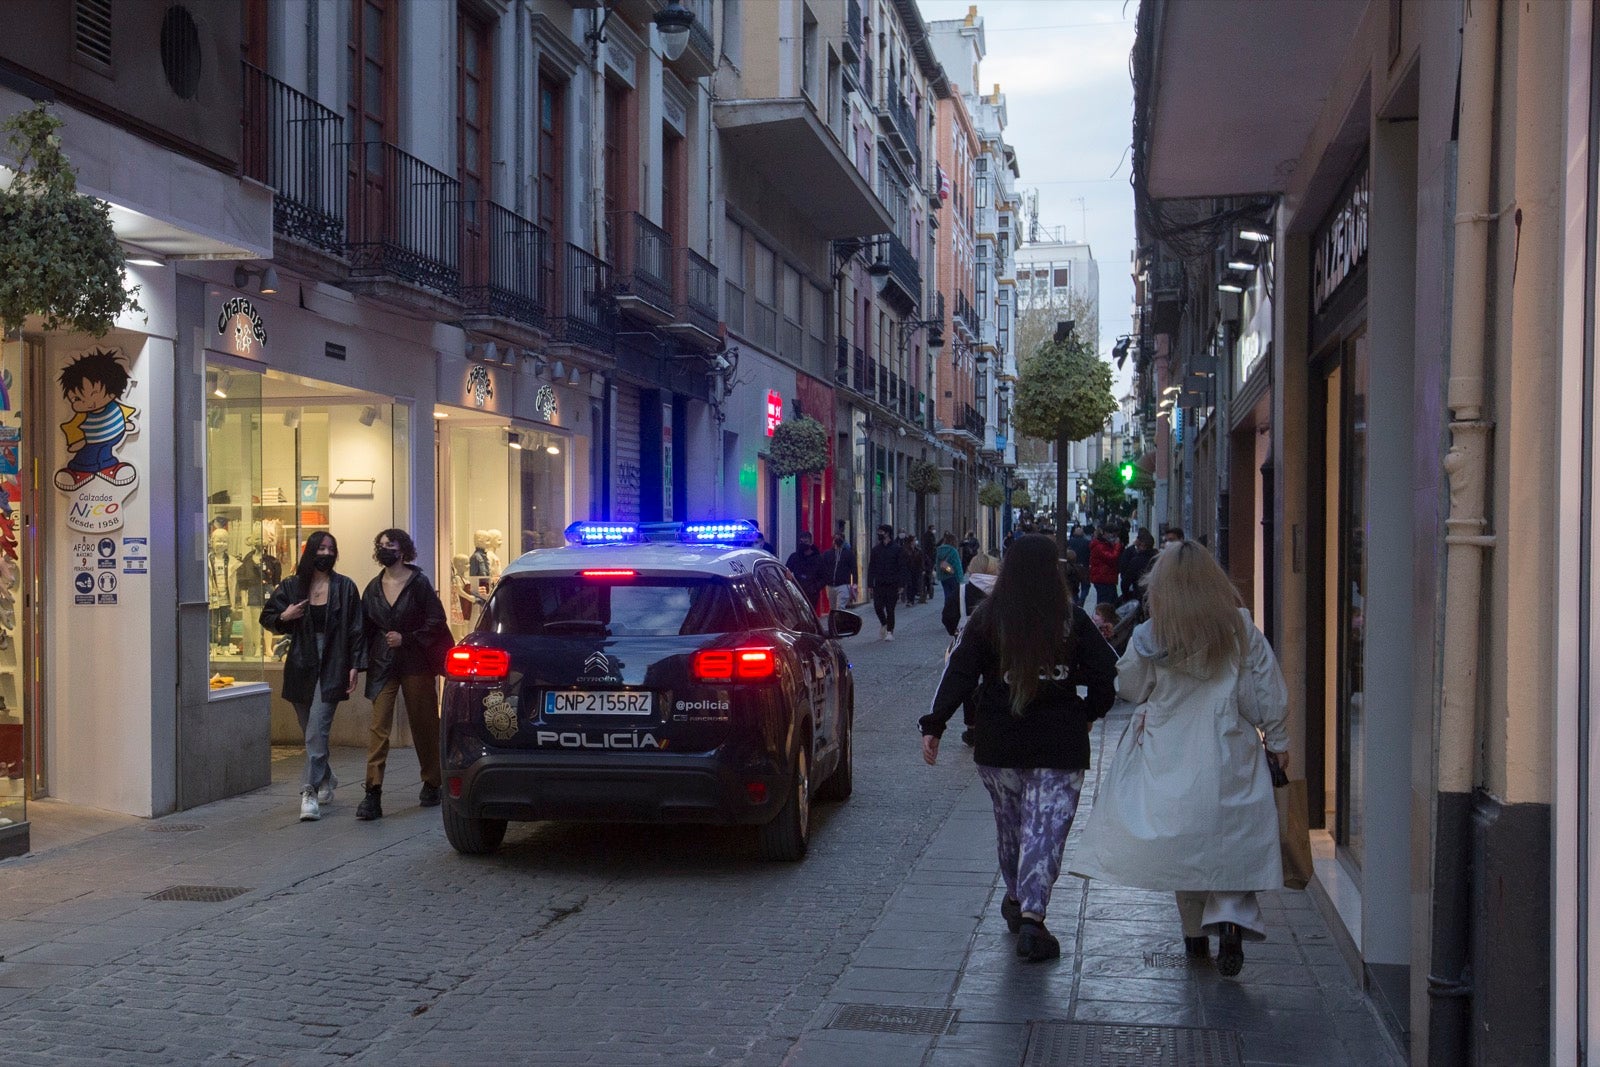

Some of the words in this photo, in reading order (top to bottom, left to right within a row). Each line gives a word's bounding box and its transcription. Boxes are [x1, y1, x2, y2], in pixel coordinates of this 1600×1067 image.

[79, 493, 113, 502] Calzados
[69, 516, 95, 529] desde
[98, 517, 120, 529] 1958
[73, 543, 96, 552] AFORO
[82, 558, 87, 567] 9
[675, 700, 729, 711] @policia
[537, 730, 660, 748] POLICÍA
